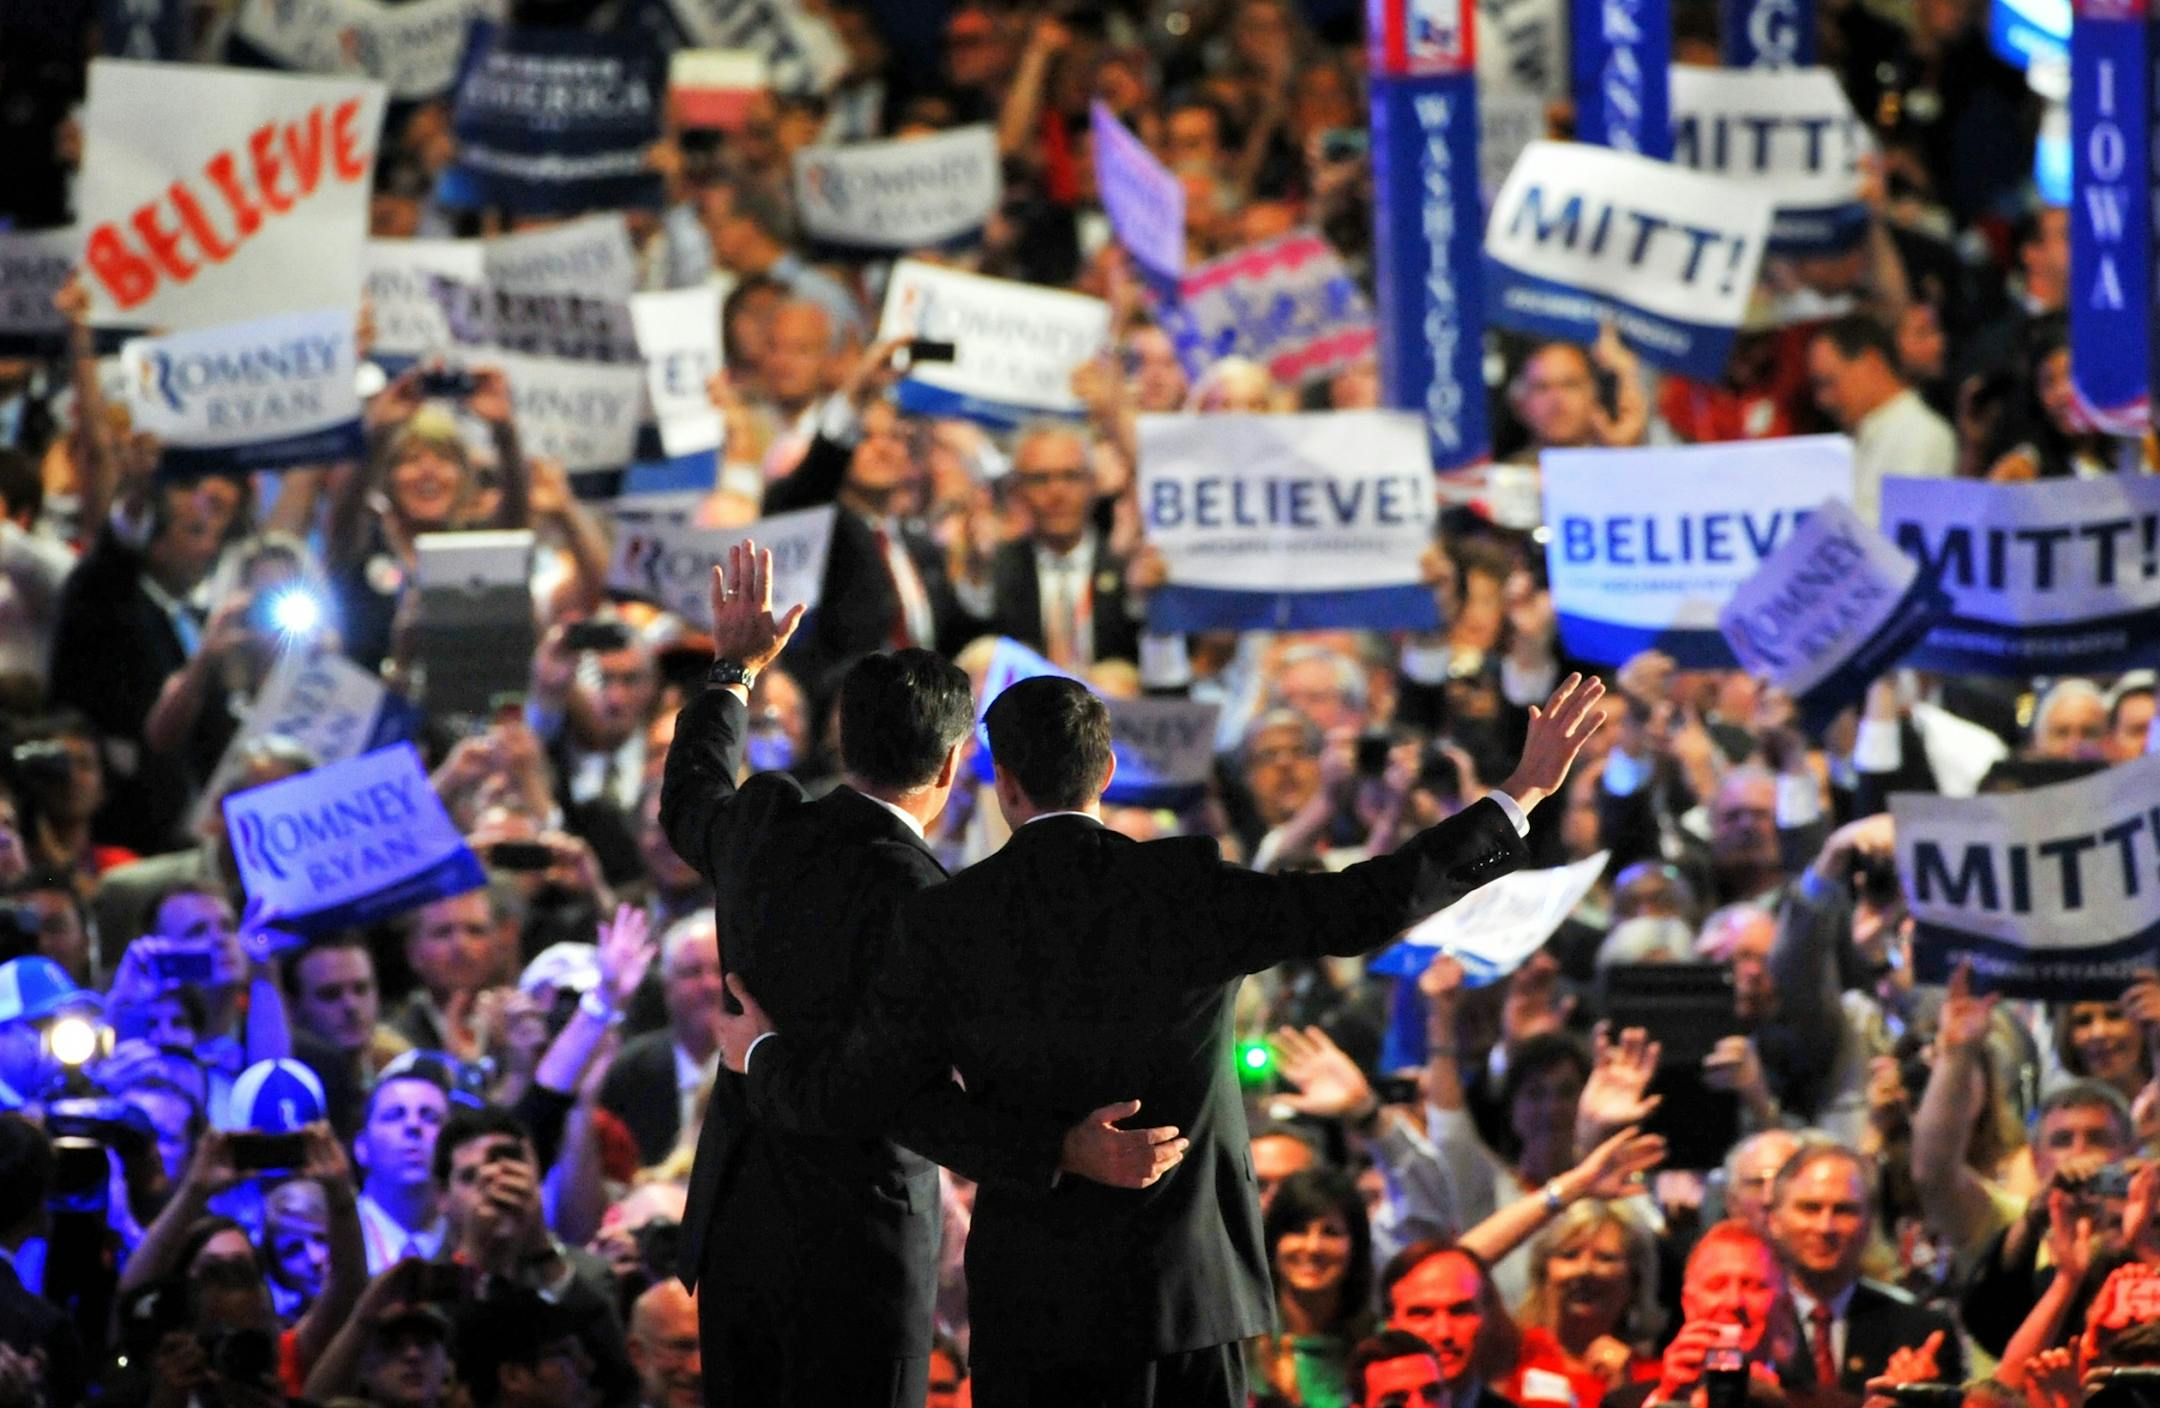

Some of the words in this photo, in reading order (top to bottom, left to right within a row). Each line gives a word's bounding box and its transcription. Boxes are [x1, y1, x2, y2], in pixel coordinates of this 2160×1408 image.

[86, 97, 367, 311] BELIEVE
[2084, 58, 2129, 311] IOWA
[1413, 93, 1462, 448] WASHINGTON
[1508, 184, 1749, 297] MITT!
[139, 333, 342, 414] ROMNEY
[206, 386, 322, 429] RYAN
[1150, 473, 1425, 529] BELIEVE!
[1895, 512, 2159, 592] MITT!
[1733, 522, 1864, 669] ROMNEY
[237, 774, 416, 880] ROMNEY
[305, 829, 417, 893] RYAN
